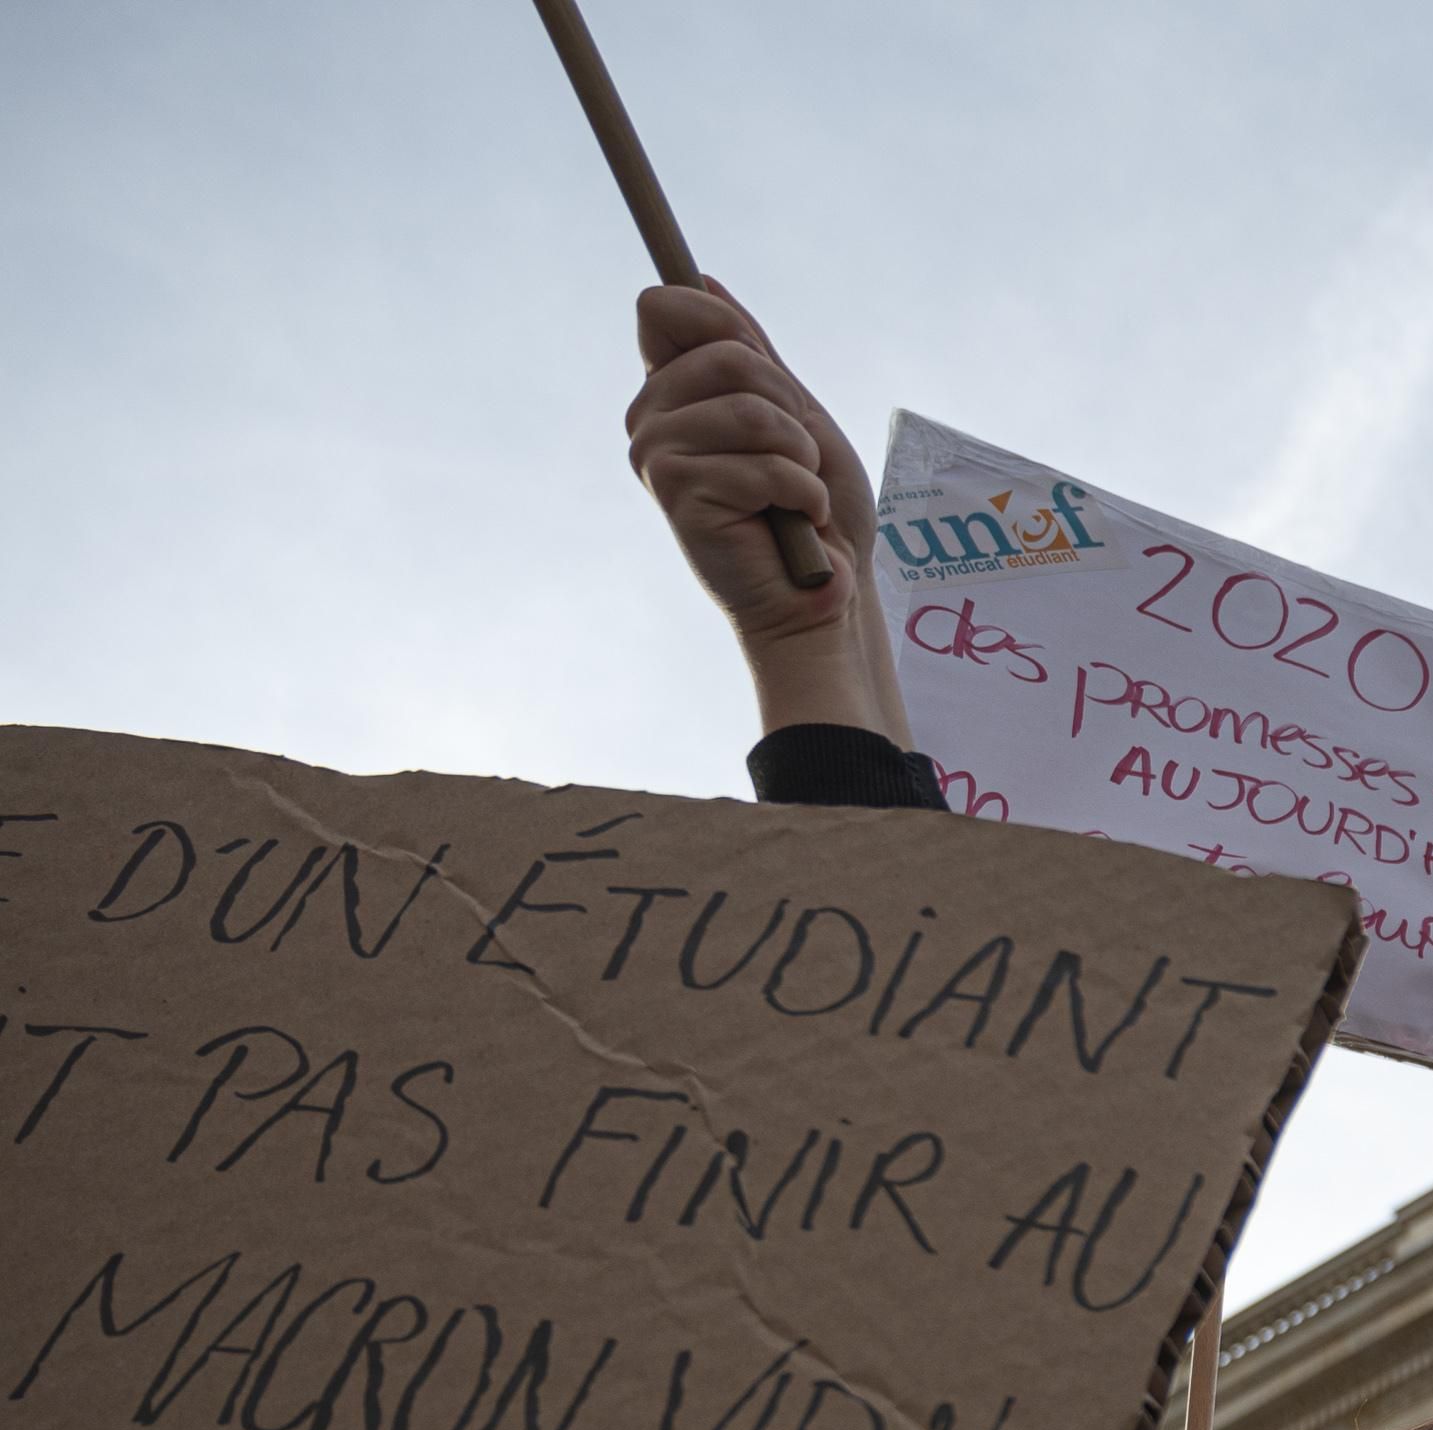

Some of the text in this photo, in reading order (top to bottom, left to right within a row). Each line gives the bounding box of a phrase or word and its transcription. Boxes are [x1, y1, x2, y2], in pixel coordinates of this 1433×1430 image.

[878, 481, 1105, 568] unef
[899, 549, 1080, 582] le syndicat étudiant
[905, 598, 1048, 683] des
[1136, 545, 1430, 711] 2020
[88, 821, 451, 958] D'UN
[167, 1025, 454, 1184] PAS
[987, 1162, 1204, 1312] AU
